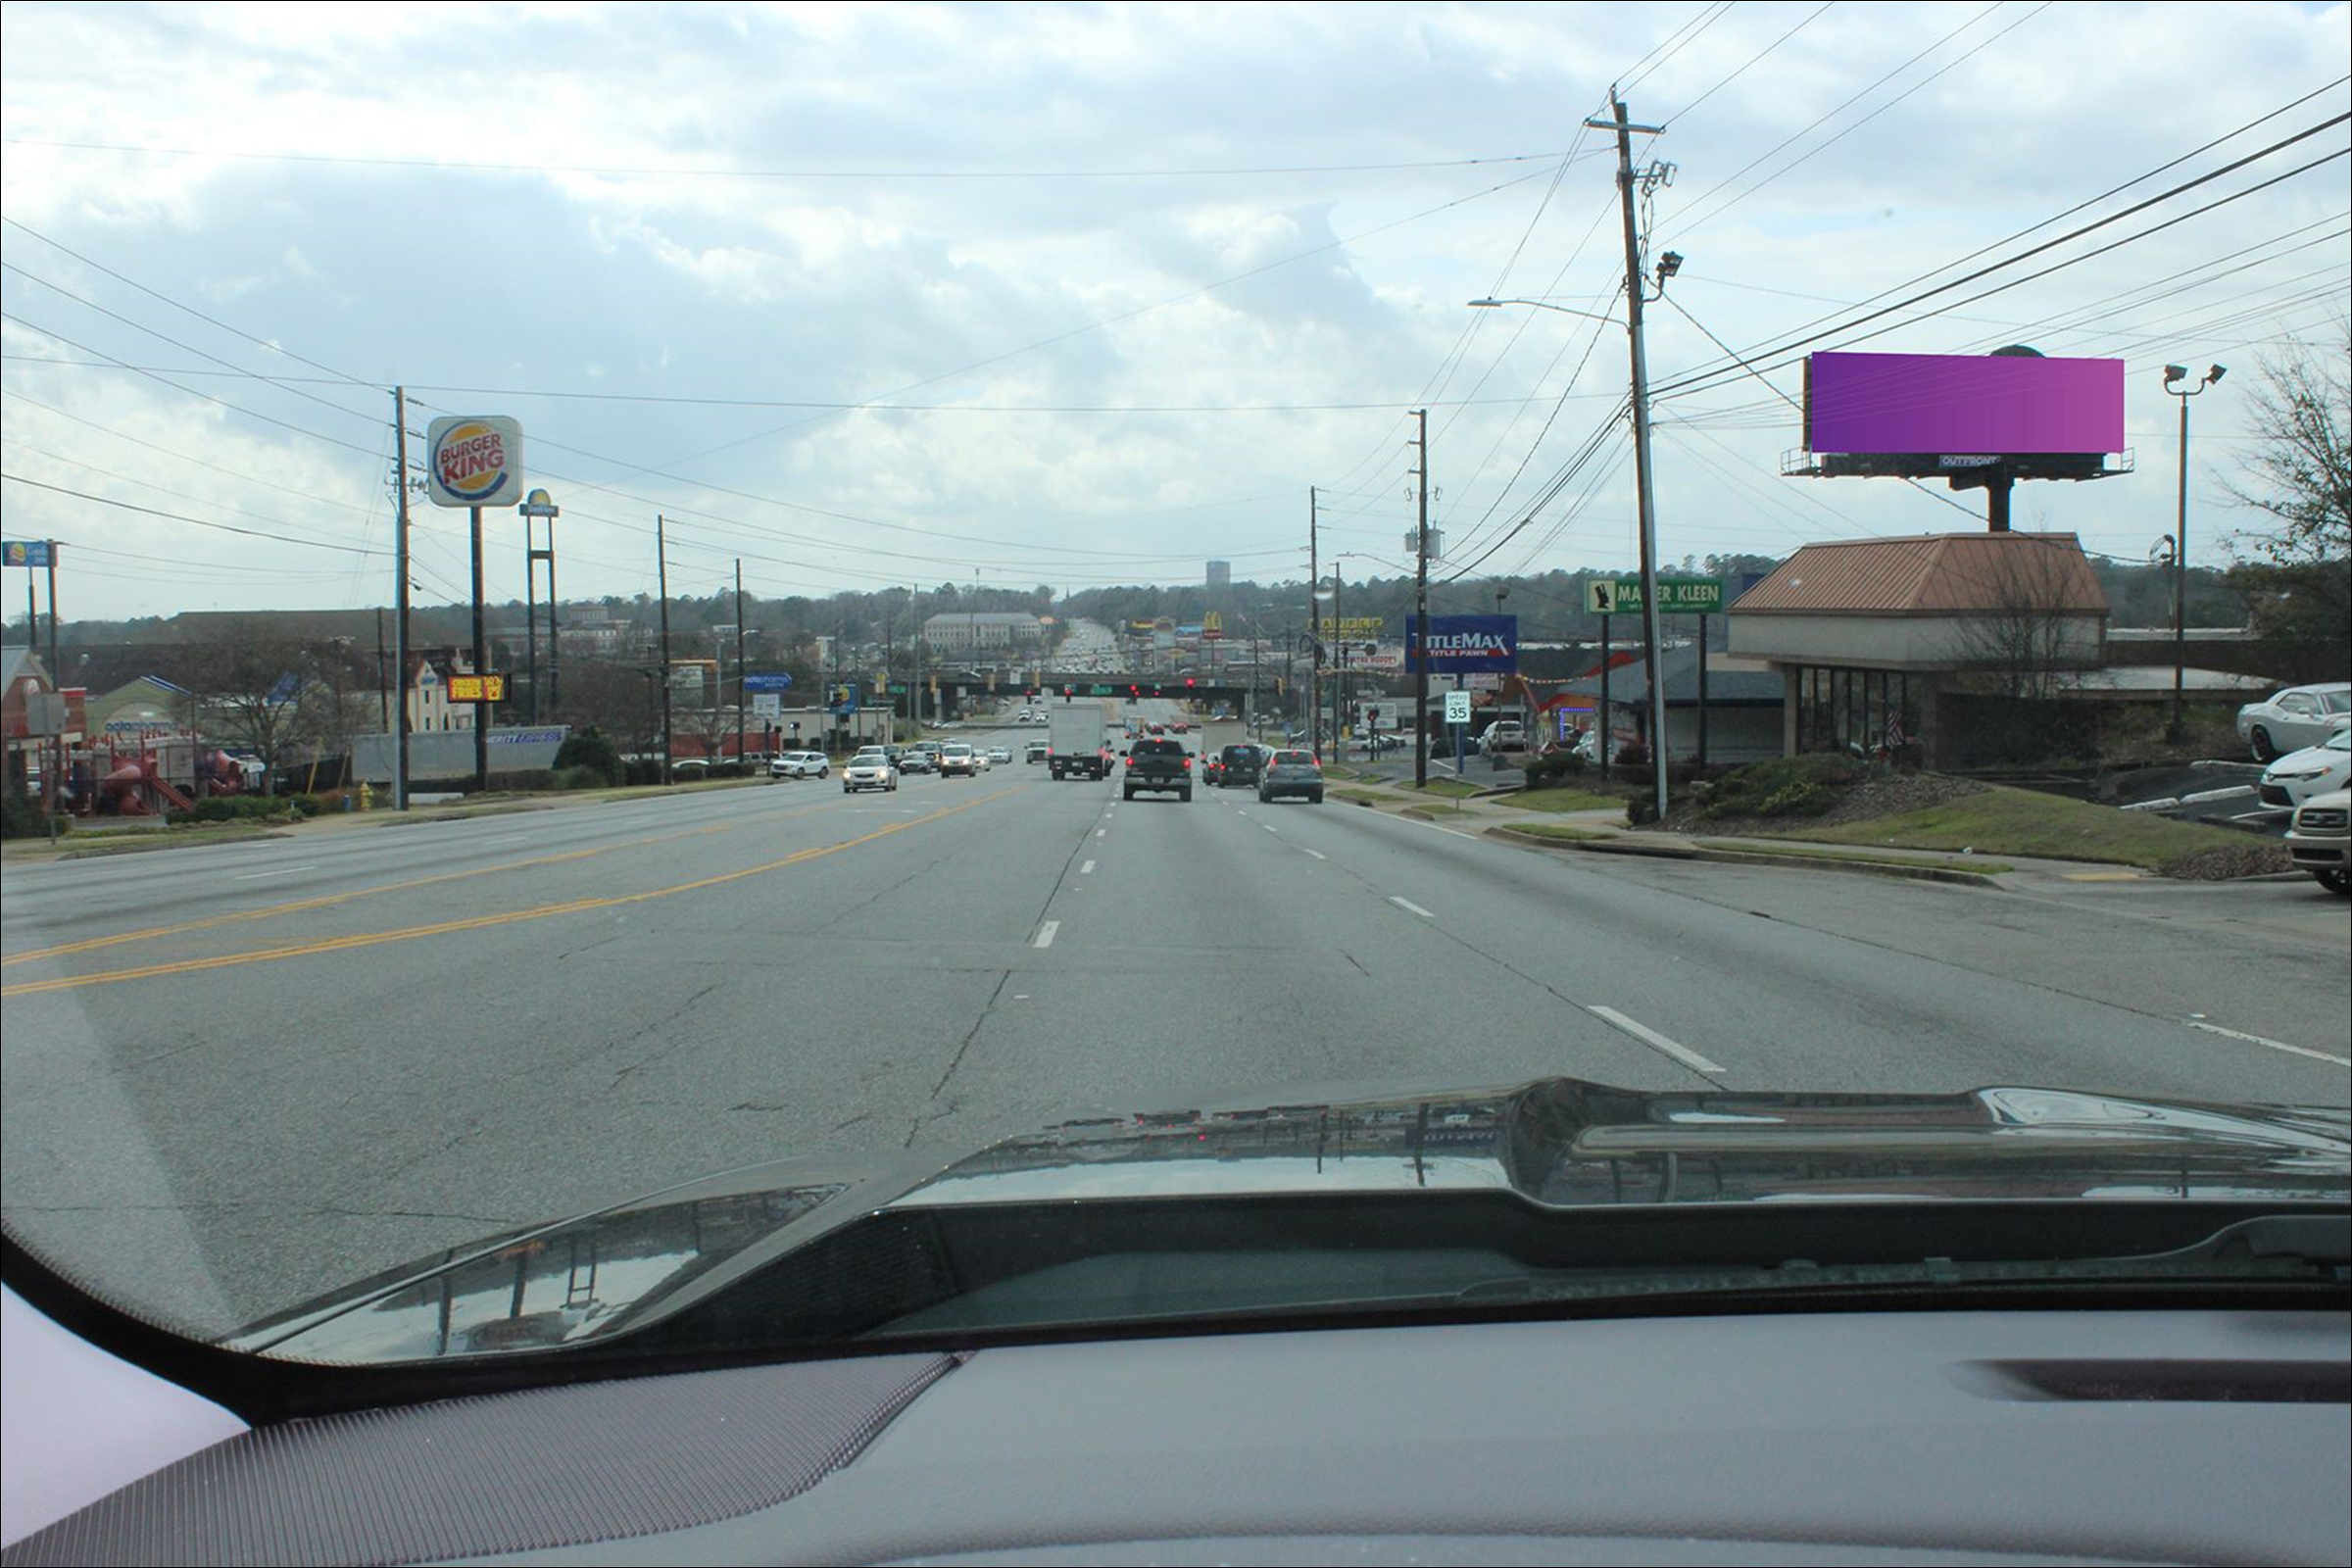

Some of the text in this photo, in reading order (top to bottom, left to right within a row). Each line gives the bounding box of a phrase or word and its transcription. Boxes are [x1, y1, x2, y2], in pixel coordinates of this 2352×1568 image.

[441, 433, 502, 466] BURGER
[443, 449, 505, 485] KING
[1618, 585, 1719, 602] MAER KLEEN
[1411, 632, 1509, 656] ITLEMAX
[1448, 707, 1467, 719] 35
